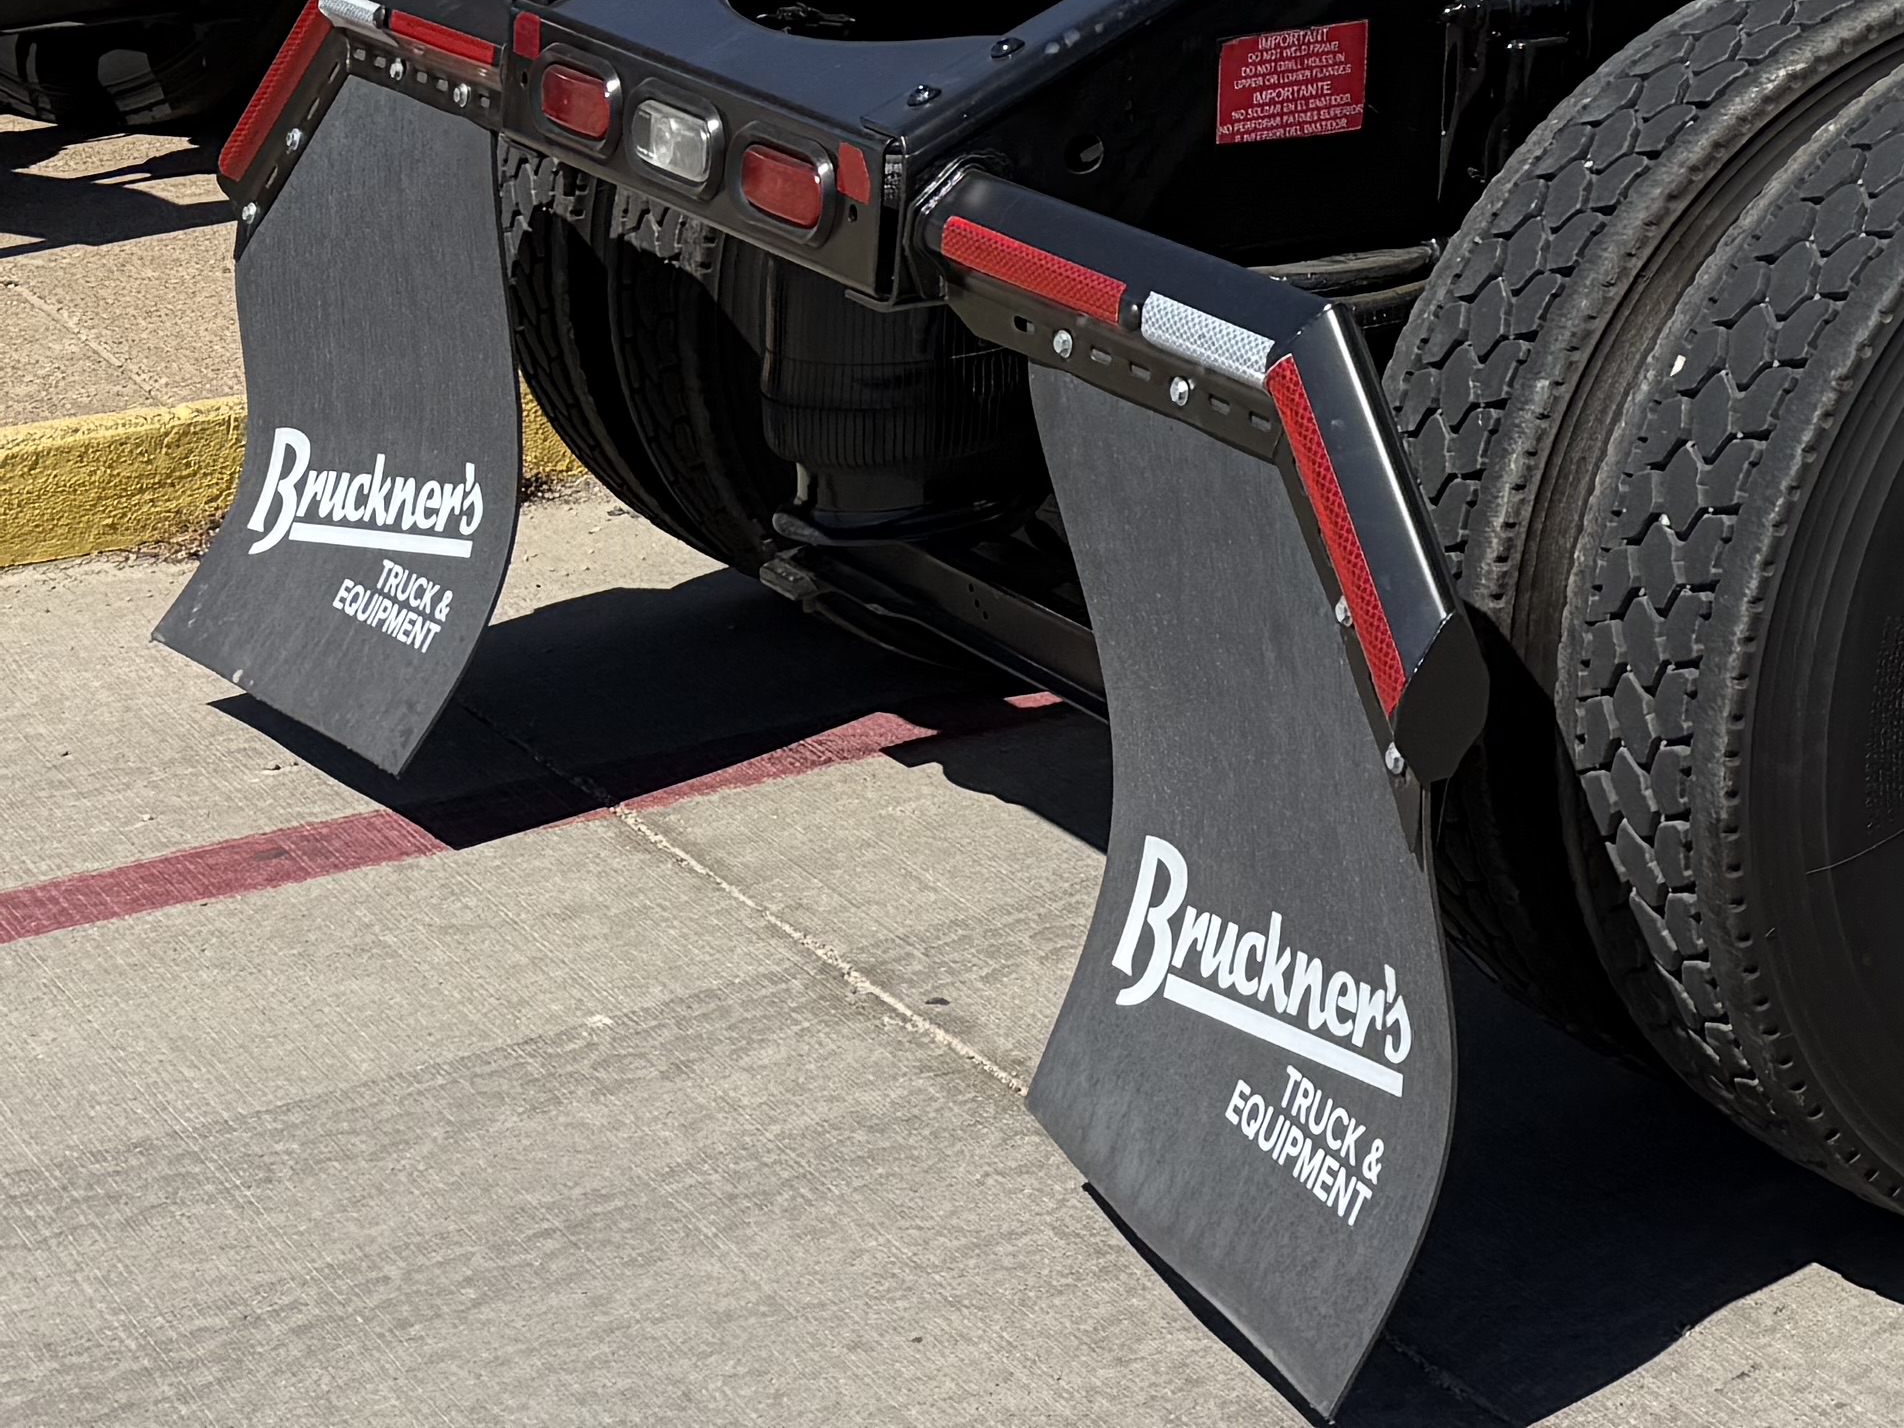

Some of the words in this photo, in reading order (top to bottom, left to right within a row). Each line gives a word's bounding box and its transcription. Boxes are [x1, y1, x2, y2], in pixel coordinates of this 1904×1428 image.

[1258, 28, 1329, 49] IMPORTANT
[1253, 81, 1332, 104] IMPORTANTE
[247, 427, 483, 555] Bruckner's
[332, 578, 441, 654] EQUIPMENT
[376, 559, 437, 614] TRUCK
[435, 590, 453, 622] &
[1111, 834, 1412, 1074] Bruckner's
[1224, 1079, 1373, 1227] EQUIPMENT
[1281, 1064, 1367, 1166] TRUCK
[1362, 1137, 1385, 1186] &
